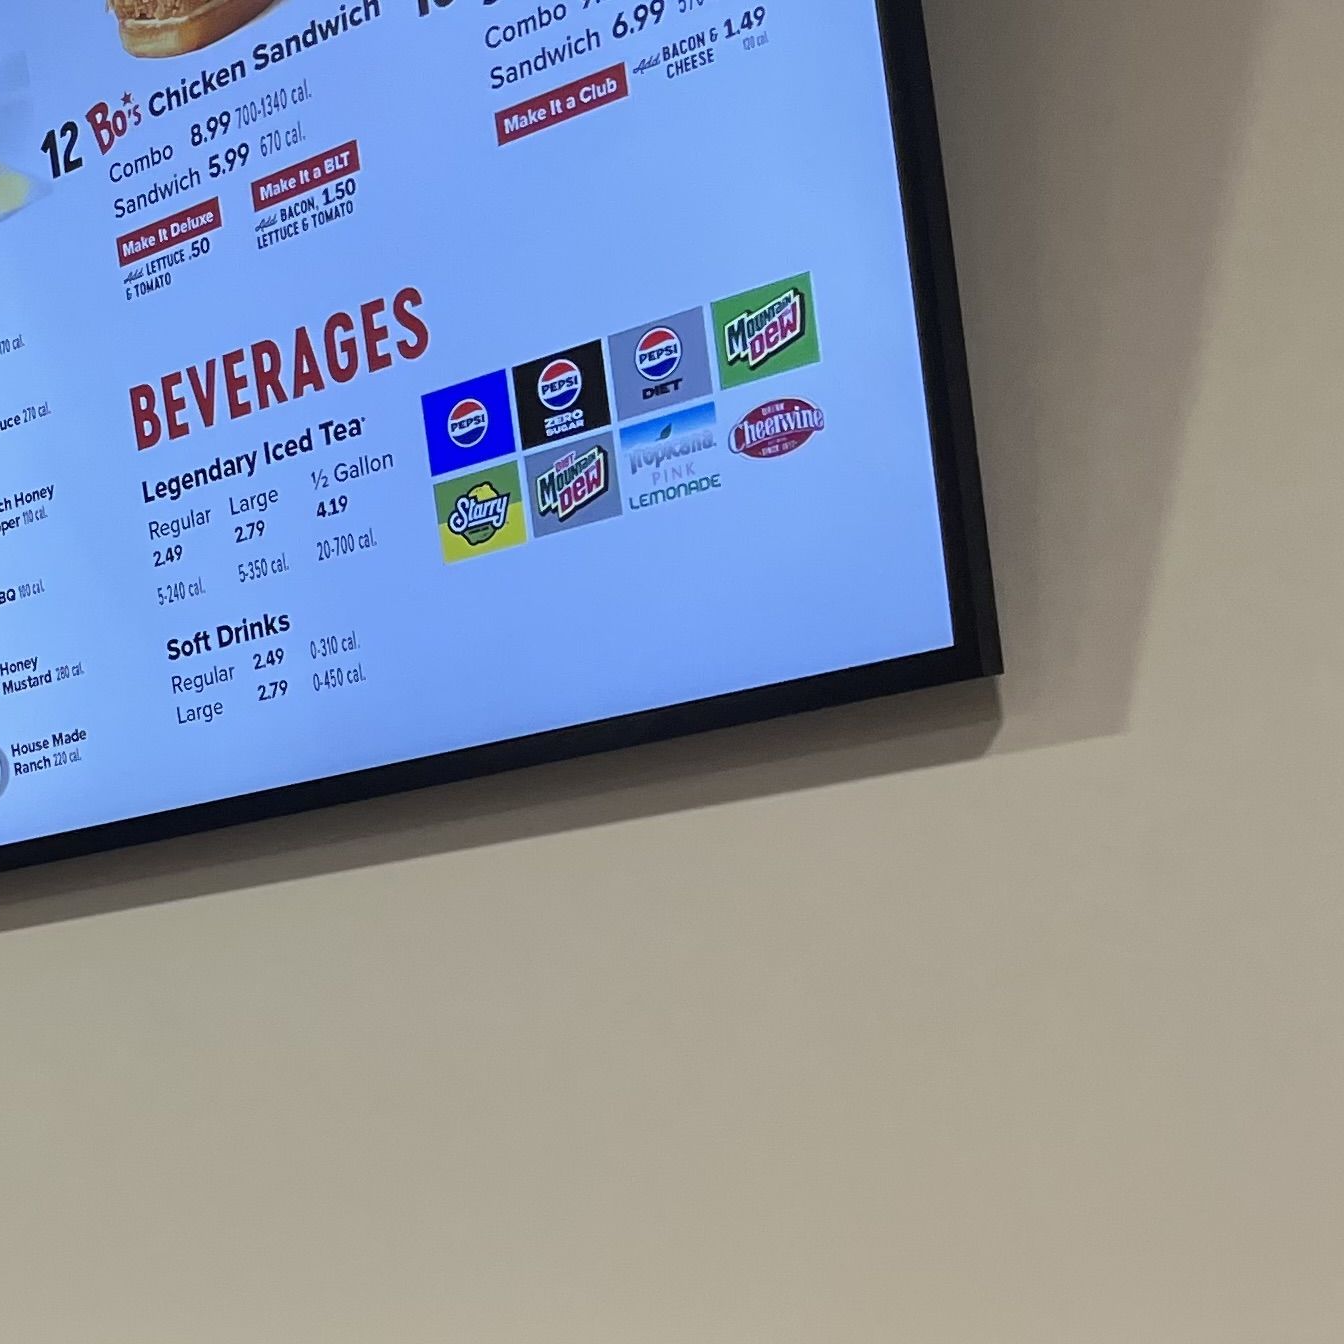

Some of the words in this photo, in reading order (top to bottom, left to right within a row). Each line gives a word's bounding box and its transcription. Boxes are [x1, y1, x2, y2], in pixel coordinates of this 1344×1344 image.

[485, 2, 567, 49] Combo
[662, 32, 705, 62] BACON
[724, 6, 765, 40] 1.49
[490, 29, 601, 90] Sandwich
[667, 48, 714, 79] CHEESE
[41, 121, 83, 179] 12
[148, 60, 247, 117] Chicken
[253, 0, 380, 71] Sandwich
[504, 108, 547, 135] Make
[580, 77, 617, 105] Club
[110, 144, 173, 184] Combo
[190, 111, 231, 148] 8.99
[114, 167, 202, 218] Sandwich
[209, 143, 249, 179] 5.99
[259, 176, 296, 201] Make
[324, 152, 350, 175] BLT
[122, 237, 155, 258] Make
[171, 211, 214, 237] Deluxe
[257, 221, 299, 250] LETTUCE
[312, 200, 353, 229] TOMATO
[146, 249, 185, 276] LETTUCE
[135, 272, 172, 298] TOMATO
[129, 287, 429, 452] BEVERAGES
[639, 344, 677, 365] PEPSI
[541, 375, 578, 396] PEPSI
[451, 413, 485, 432] PEPSI
[728, 405, 824, 453] Cheerwine
[142, 451, 257, 503] Legendary
[264, 428, 313, 465] Iced
[334, 452, 394, 482] Gallon
[14, 485, 54, 508] Honey
[629, 474, 721, 510] LEMONADE
[148, 508, 212, 540] Regular
[229, 488, 278, 516] Large
[167, 631, 212, 660] Soft
[216, 614, 290, 648] Drinks
[0, 656, 39, 677] Honey
[2, 671, 53, 695] Mustard
[171, 666, 235, 694] Regular
[176, 701, 224, 724] Large
[11, 738, 49, 757] House
[52, 729, 87, 748] Made
[14, 756, 51, 776] Ranch
